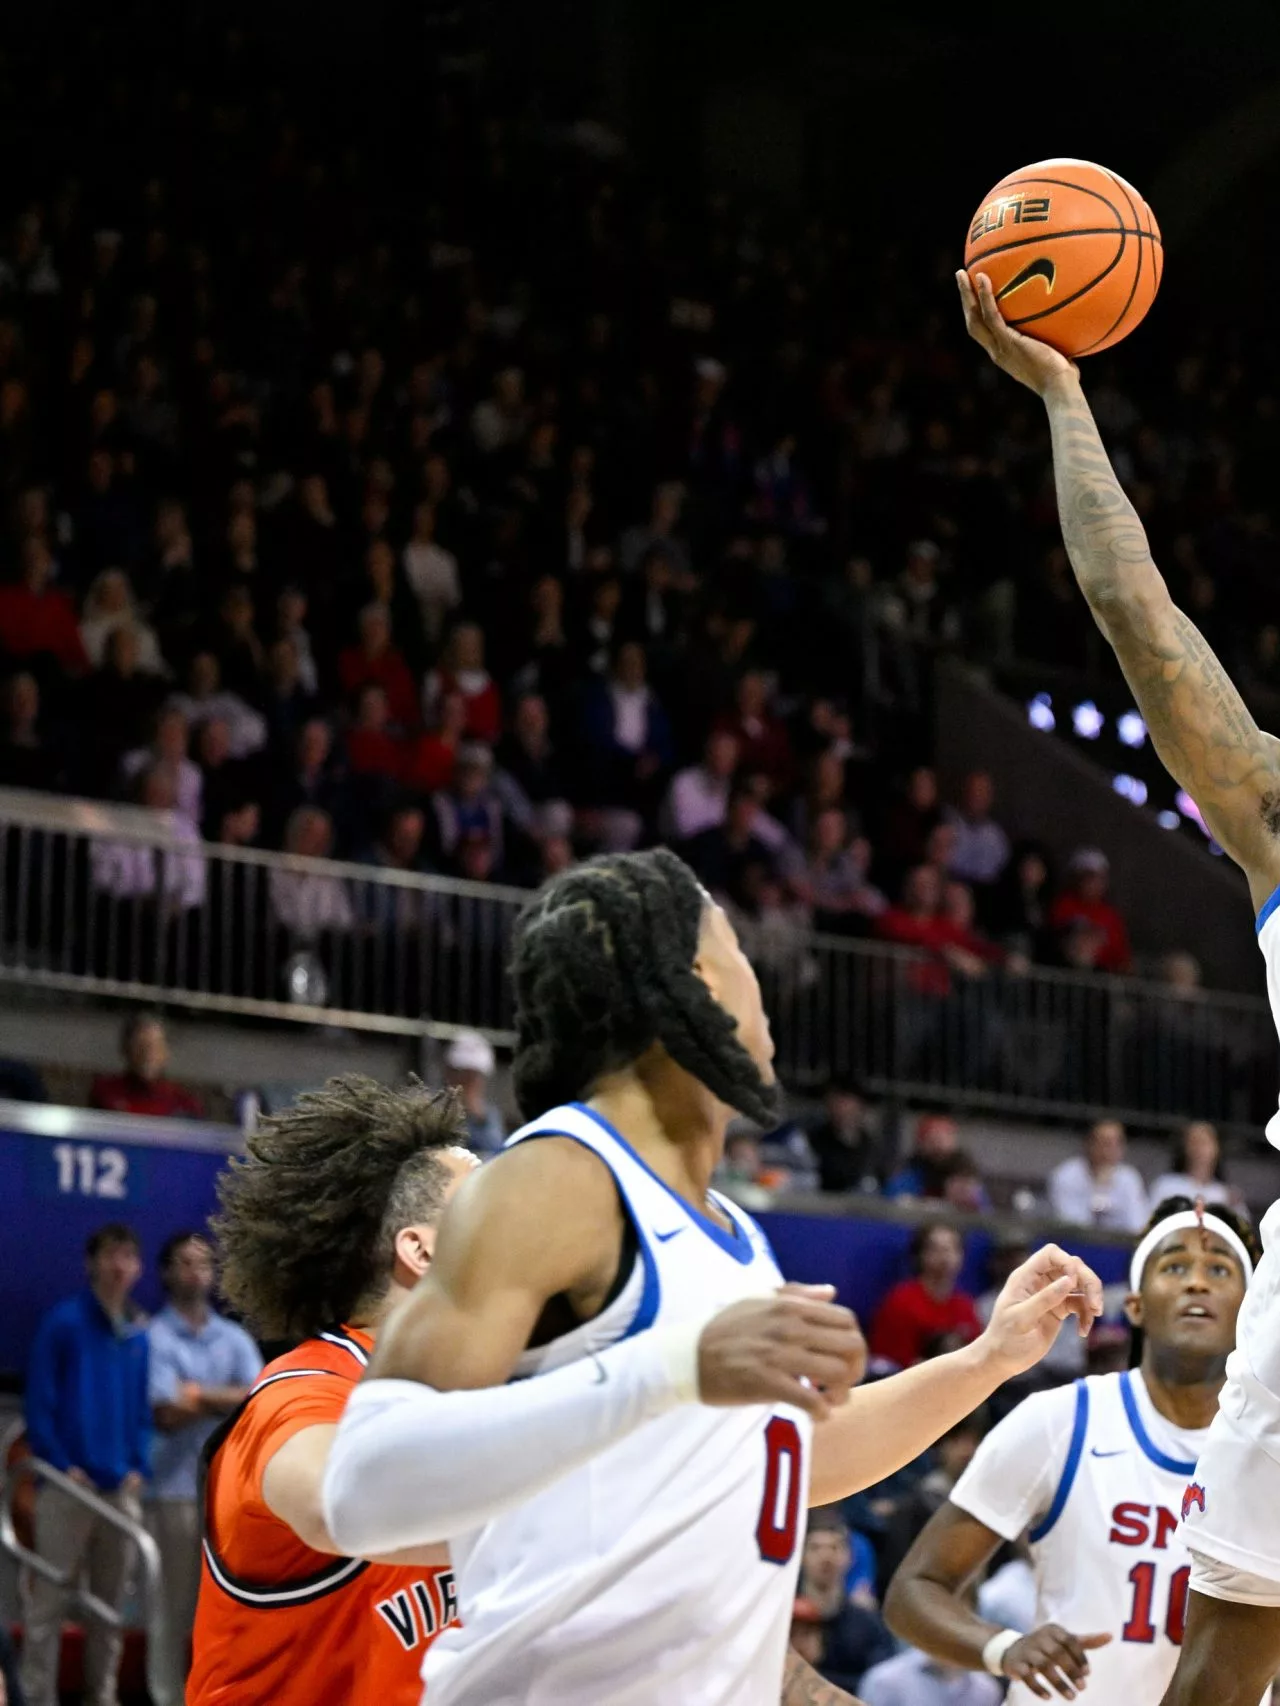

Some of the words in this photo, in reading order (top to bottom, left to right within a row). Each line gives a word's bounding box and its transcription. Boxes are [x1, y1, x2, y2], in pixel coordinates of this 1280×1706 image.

[52, 1143, 128, 1199] 112
[755, 1414, 802, 1567] 0
[374, 1567, 456, 1651] VIR
